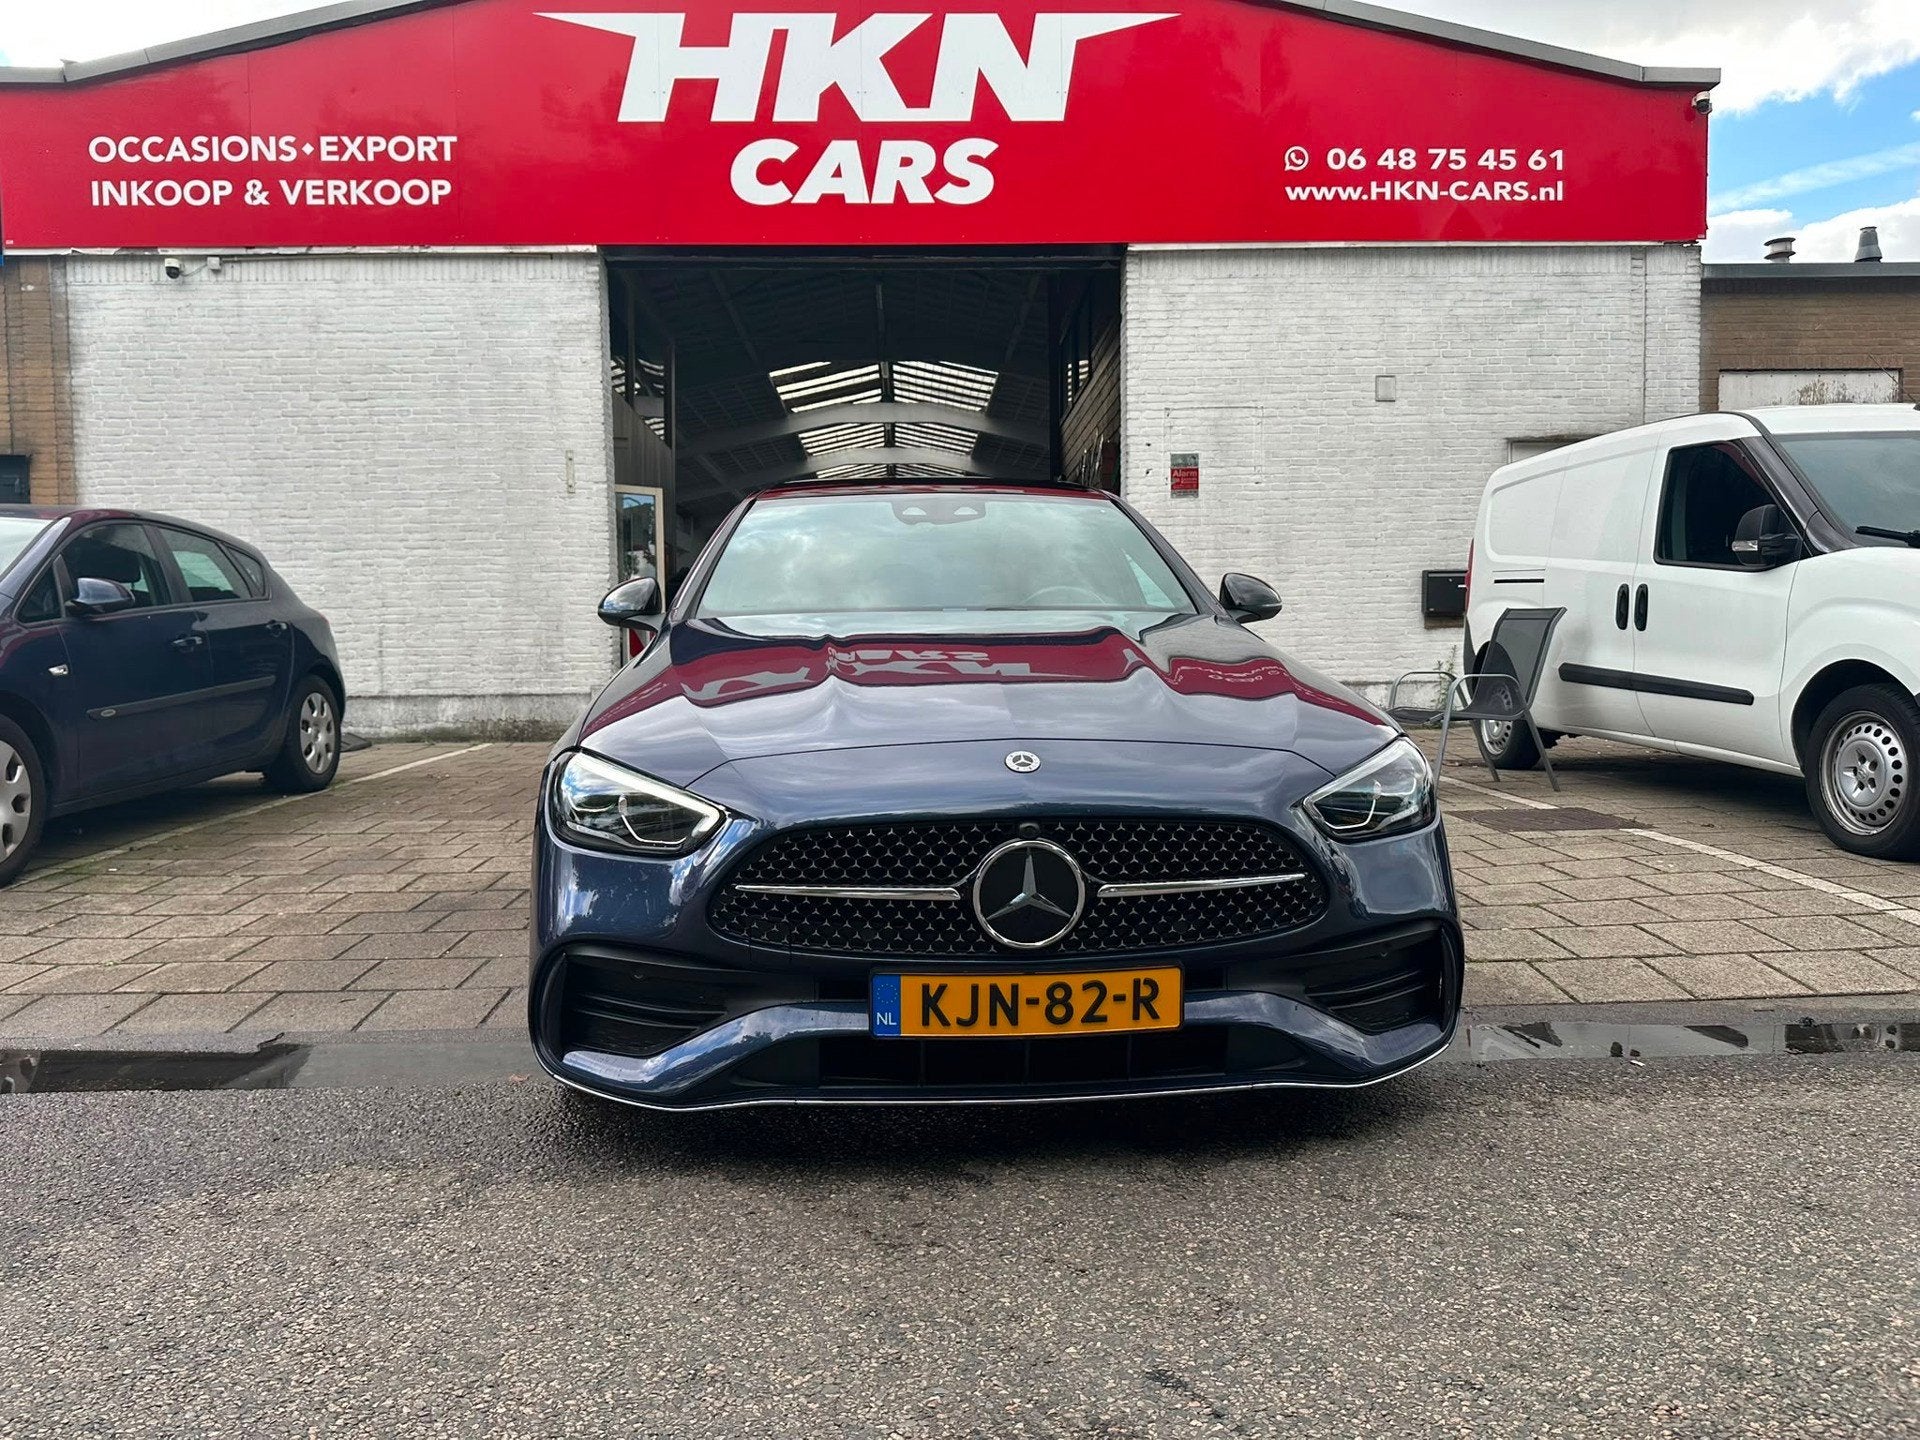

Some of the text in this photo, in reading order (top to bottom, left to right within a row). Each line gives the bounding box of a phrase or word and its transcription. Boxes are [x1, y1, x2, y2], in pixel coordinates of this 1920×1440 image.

[533, 12, 1180, 123] HKN
[88, 135, 458, 163] OCCASIONS EXPORT
[1326, 147, 1563, 171] 06 48 75 45 61
[730, 138, 998, 206] CARS
[91, 178, 452, 206] INKOOP & VERKOOP
[1284, 180, 1564, 202] www.HKN-CARS.nl
[1172, 469, 1198, 477] Alarm
[876, 977, 1161, 1028] NL KJN-82-R
